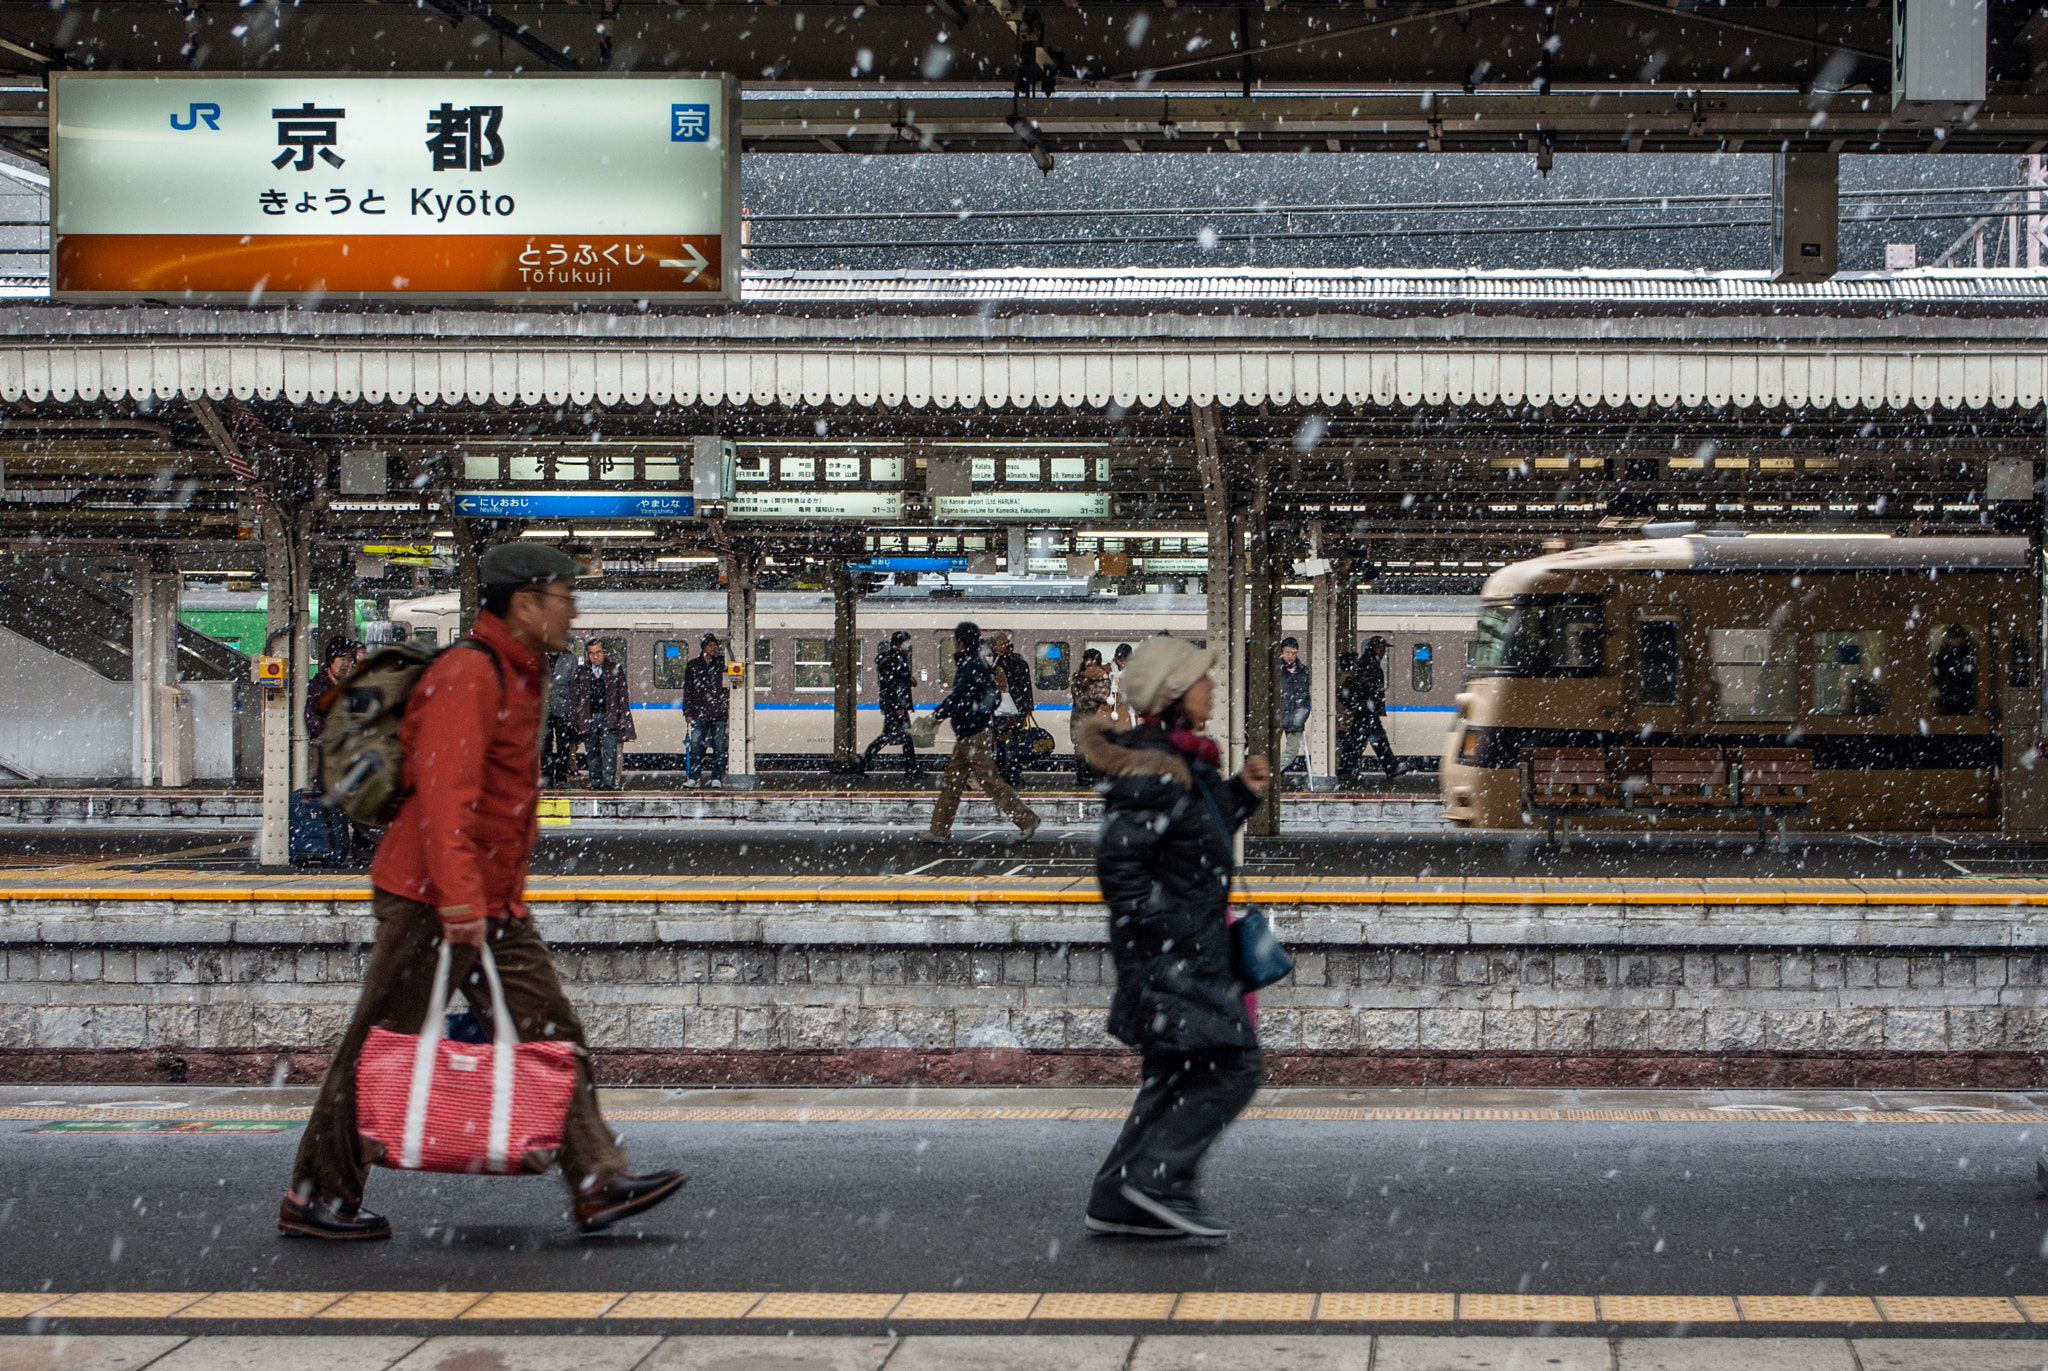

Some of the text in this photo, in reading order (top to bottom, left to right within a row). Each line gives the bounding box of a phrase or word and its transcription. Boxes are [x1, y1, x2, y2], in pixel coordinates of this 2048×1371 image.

[170, 103, 221, 131] JR
[675, 108, 706, 138] 京
[271, 102, 505, 172] 京都
[258, 188, 386, 216] きょうと
[410, 187, 516, 223] Kyōto
[518, 243, 646, 266] とうふくじ
[518, 268, 611, 286] Tōfukuji
[480, 498, 529, 507] にしおおじ
[640, 499, 681, 508] やましな
[1094, 498, 1104, 506] 30
